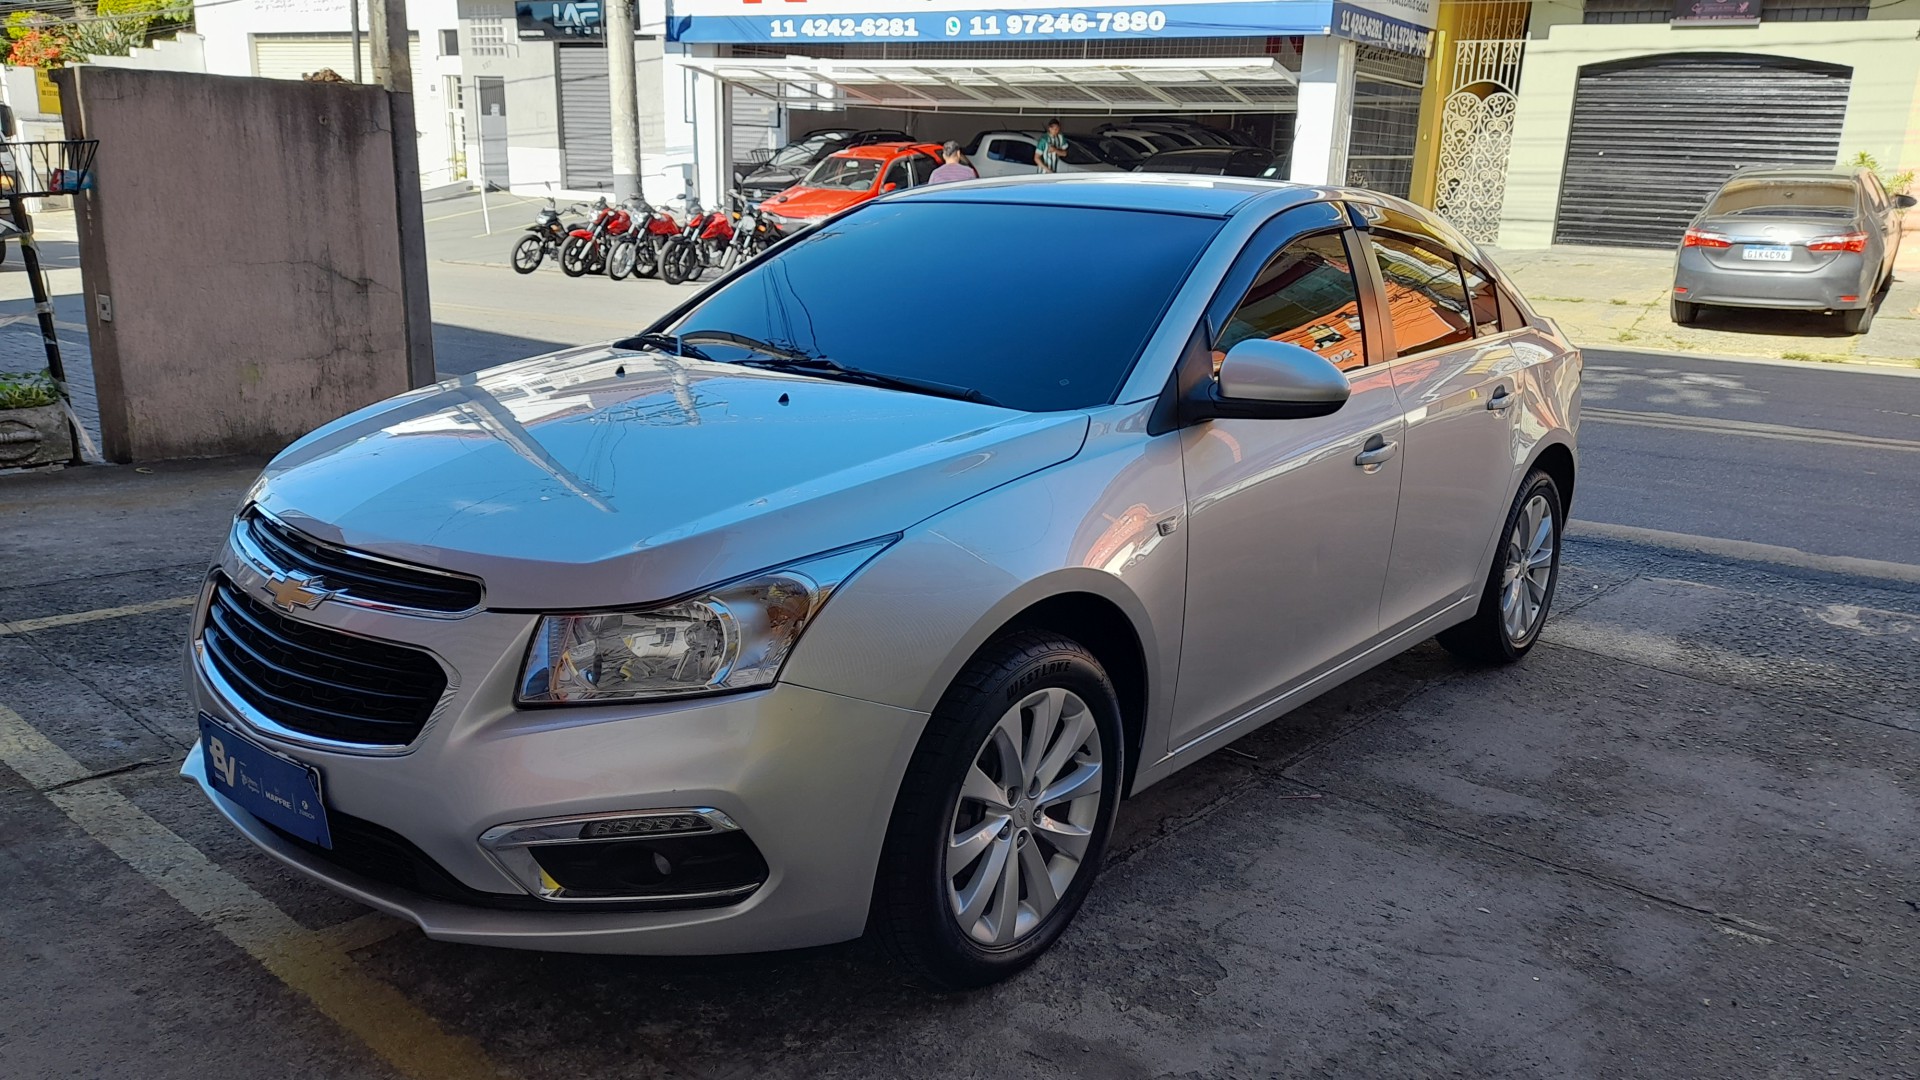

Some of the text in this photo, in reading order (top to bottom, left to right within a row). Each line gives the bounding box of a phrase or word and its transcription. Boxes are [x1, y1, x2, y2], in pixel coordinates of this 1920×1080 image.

[553, 3, 599, 27] LAF
[770, 11, 1166, 38] 11 4242-6281 11 97246-7880
[1341, 10, 1350, 31] 11
[565, 26, 604, 35] STOR
[1006, 661, 1071, 700] WESTLAKE
[209, 735, 236, 788] BV
[265, 791, 292, 810] MAPFRE
